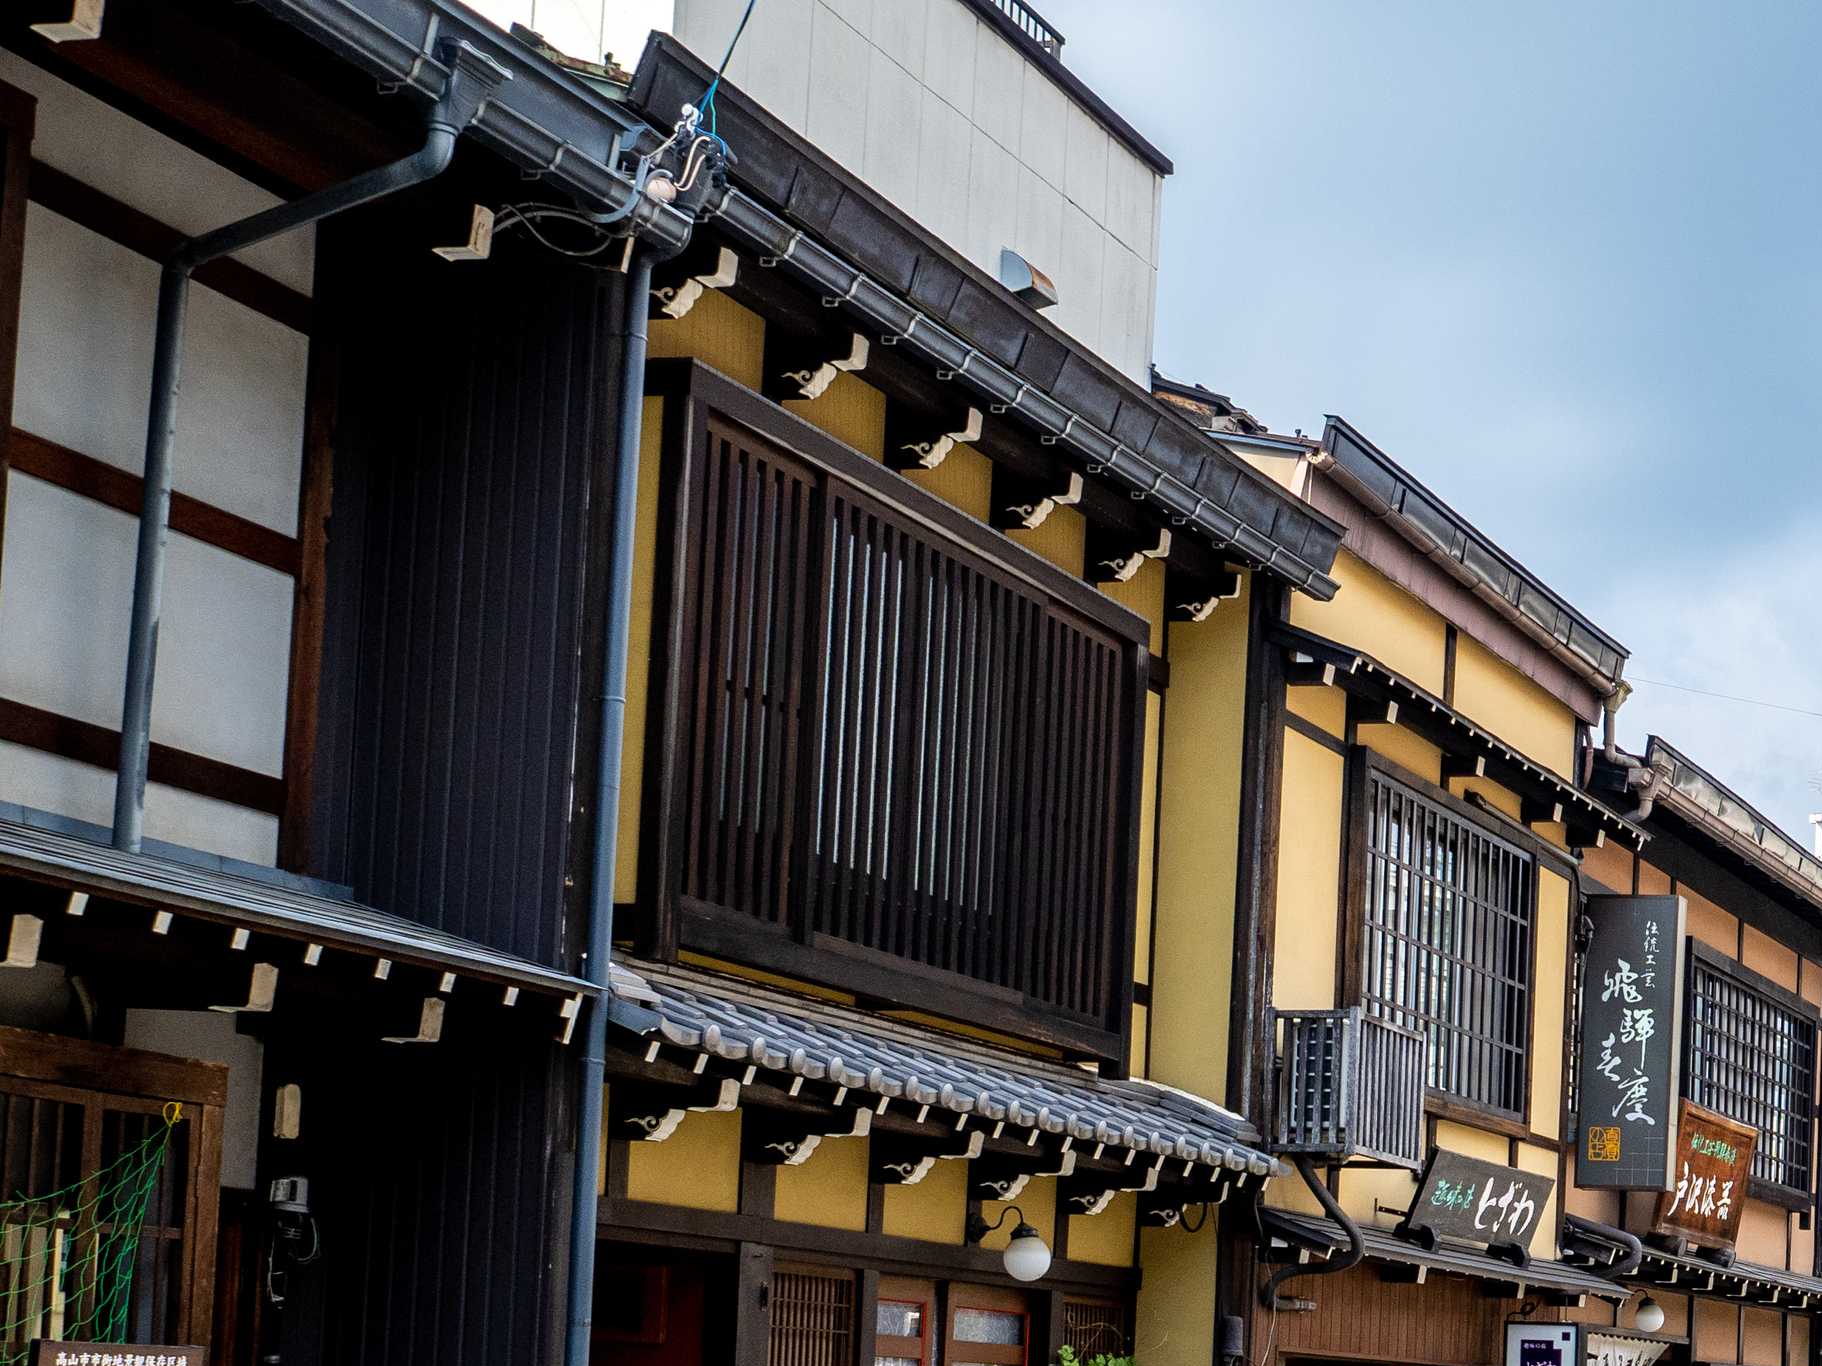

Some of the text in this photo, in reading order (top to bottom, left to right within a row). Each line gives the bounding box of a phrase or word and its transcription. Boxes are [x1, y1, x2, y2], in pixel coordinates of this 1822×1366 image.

[1641, 921, 1660, 989] 伝統工芸
[1474, 1177, 1535, 1236] とざわ
